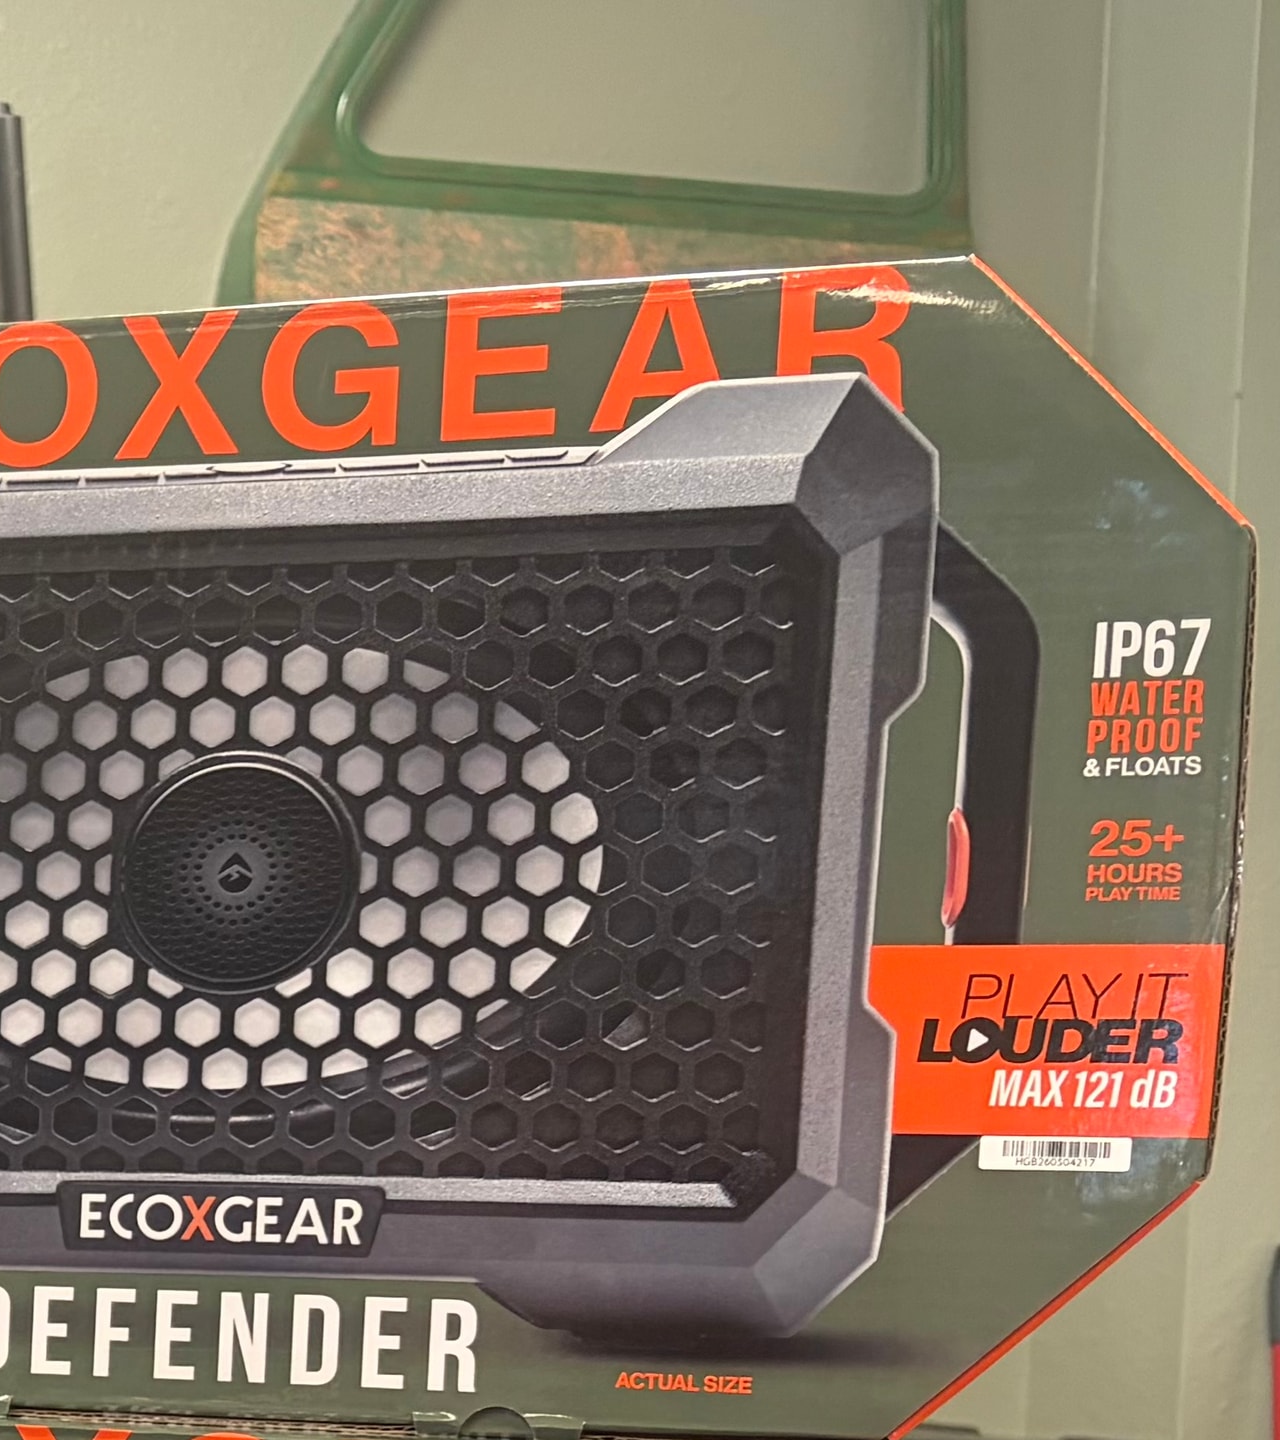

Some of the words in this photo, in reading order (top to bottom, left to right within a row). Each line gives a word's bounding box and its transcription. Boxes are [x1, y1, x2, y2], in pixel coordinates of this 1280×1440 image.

[1092, 618, 1212, 679] IP67
[1090, 679, 1205, 717] WATER
[1086, 717, 1204, 755] PROOF
[1082, 759, 1101, 778] &
[1104, 756, 1202, 777] FLOATS
[1088, 819, 1185, 858] 25+
[1086, 863, 1183, 884] HOURS
[961, 972, 1123, 1020] PLAY
[1132, 972, 1190, 1020] IT
[917, 1017, 1185, 1064] LOUDER
[988, 1069, 1069, 1108] MAX
[1073, 1070, 1125, 1109] 121
[1129, 1070, 1178, 1110] dB
[78, 1192, 363, 1247] ECOXGEAR
[614, 1371, 699, 1393] ACTUAL
[702, 1374, 754, 1396] SIZE
